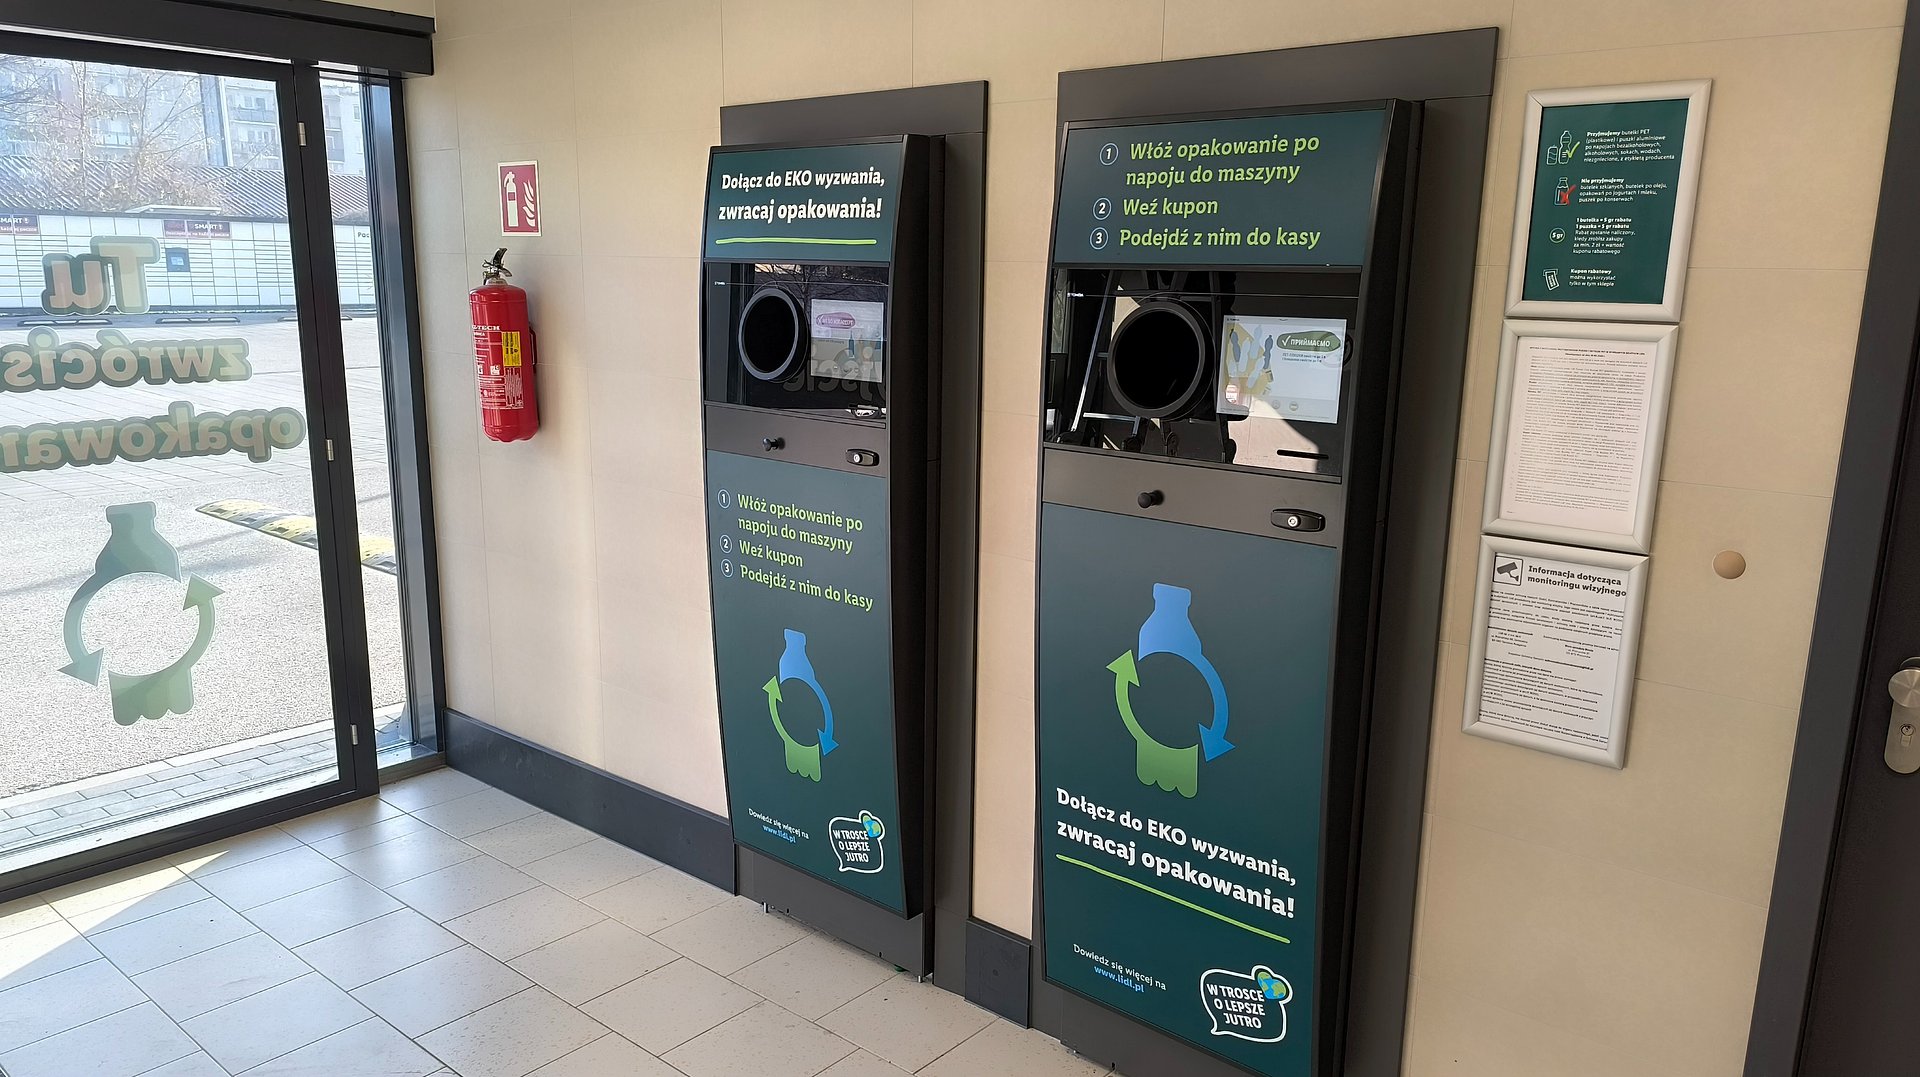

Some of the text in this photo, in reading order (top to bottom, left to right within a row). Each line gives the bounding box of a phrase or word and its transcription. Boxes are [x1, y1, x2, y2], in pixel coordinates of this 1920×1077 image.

[1130, 142, 1172, 160] Włóż
[1177, 134, 1289, 162] opakowanie
[1293, 136, 1320, 155] po
[721, 166, 885, 192] Dołącz do EKO wyzwania,
[1126, 164, 1301, 189] napoju do maszyny
[718, 196, 882, 224] zwracaj opakowania!
[1122, 198, 1158, 216] Weź
[1162, 198, 1219, 219] kupon
[1119, 227, 1189, 250] Podejdź
[1193, 233, 1203, 246] z
[1207, 228, 1242, 246] nim
[1246, 227, 1271, 246] do
[1276, 227, 1321, 250] kasy
[1290, 338, 1330, 347] ПРИЙМАЄМО
[737, 493, 767, 513] Włóż
[769, 503, 843, 527] opakowanie
[845, 517, 863, 532] po
[738, 517, 853, 555] napoju do maszyny
[739, 539, 763, 558] Weź
[766, 545, 803, 568] kupon
[740, 564, 787, 589] Podejdź
[789, 579, 796, 591] z
[799, 580, 821, 597] nim
[824, 585, 841, 602] do
[844, 588, 873, 612] kasy
[1527, 576, 1627, 597] monitoringu wizyjnego
[1528, 566, 1622, 586] Informacja dotycząca
[748, 808, 810, 839] Dowiedz się więcej na
[762, 825, 796, 844] www.lidl.pl
[833, 829, 869, 840] W TROSCE
[838, 841, 871, 852] O LEPSZE
[1056, 787, 1297, 887] Dołącz do EKO wyzwania,
[846, 852, 869, 863] JUTRO
[1056, 820, 1295, 919] zwracaj opakowania!
[1073, 943, 1167, 991] Dowiedz się więcej na
[1093, 965, 1145, 993] www.lidl.pl
[1206, 983, 1265, 1002] W TROSCE
[1214, 998, 1266, 1016] O LEPSZE
[1223, 1013, 1262, 1029] JUTRO
